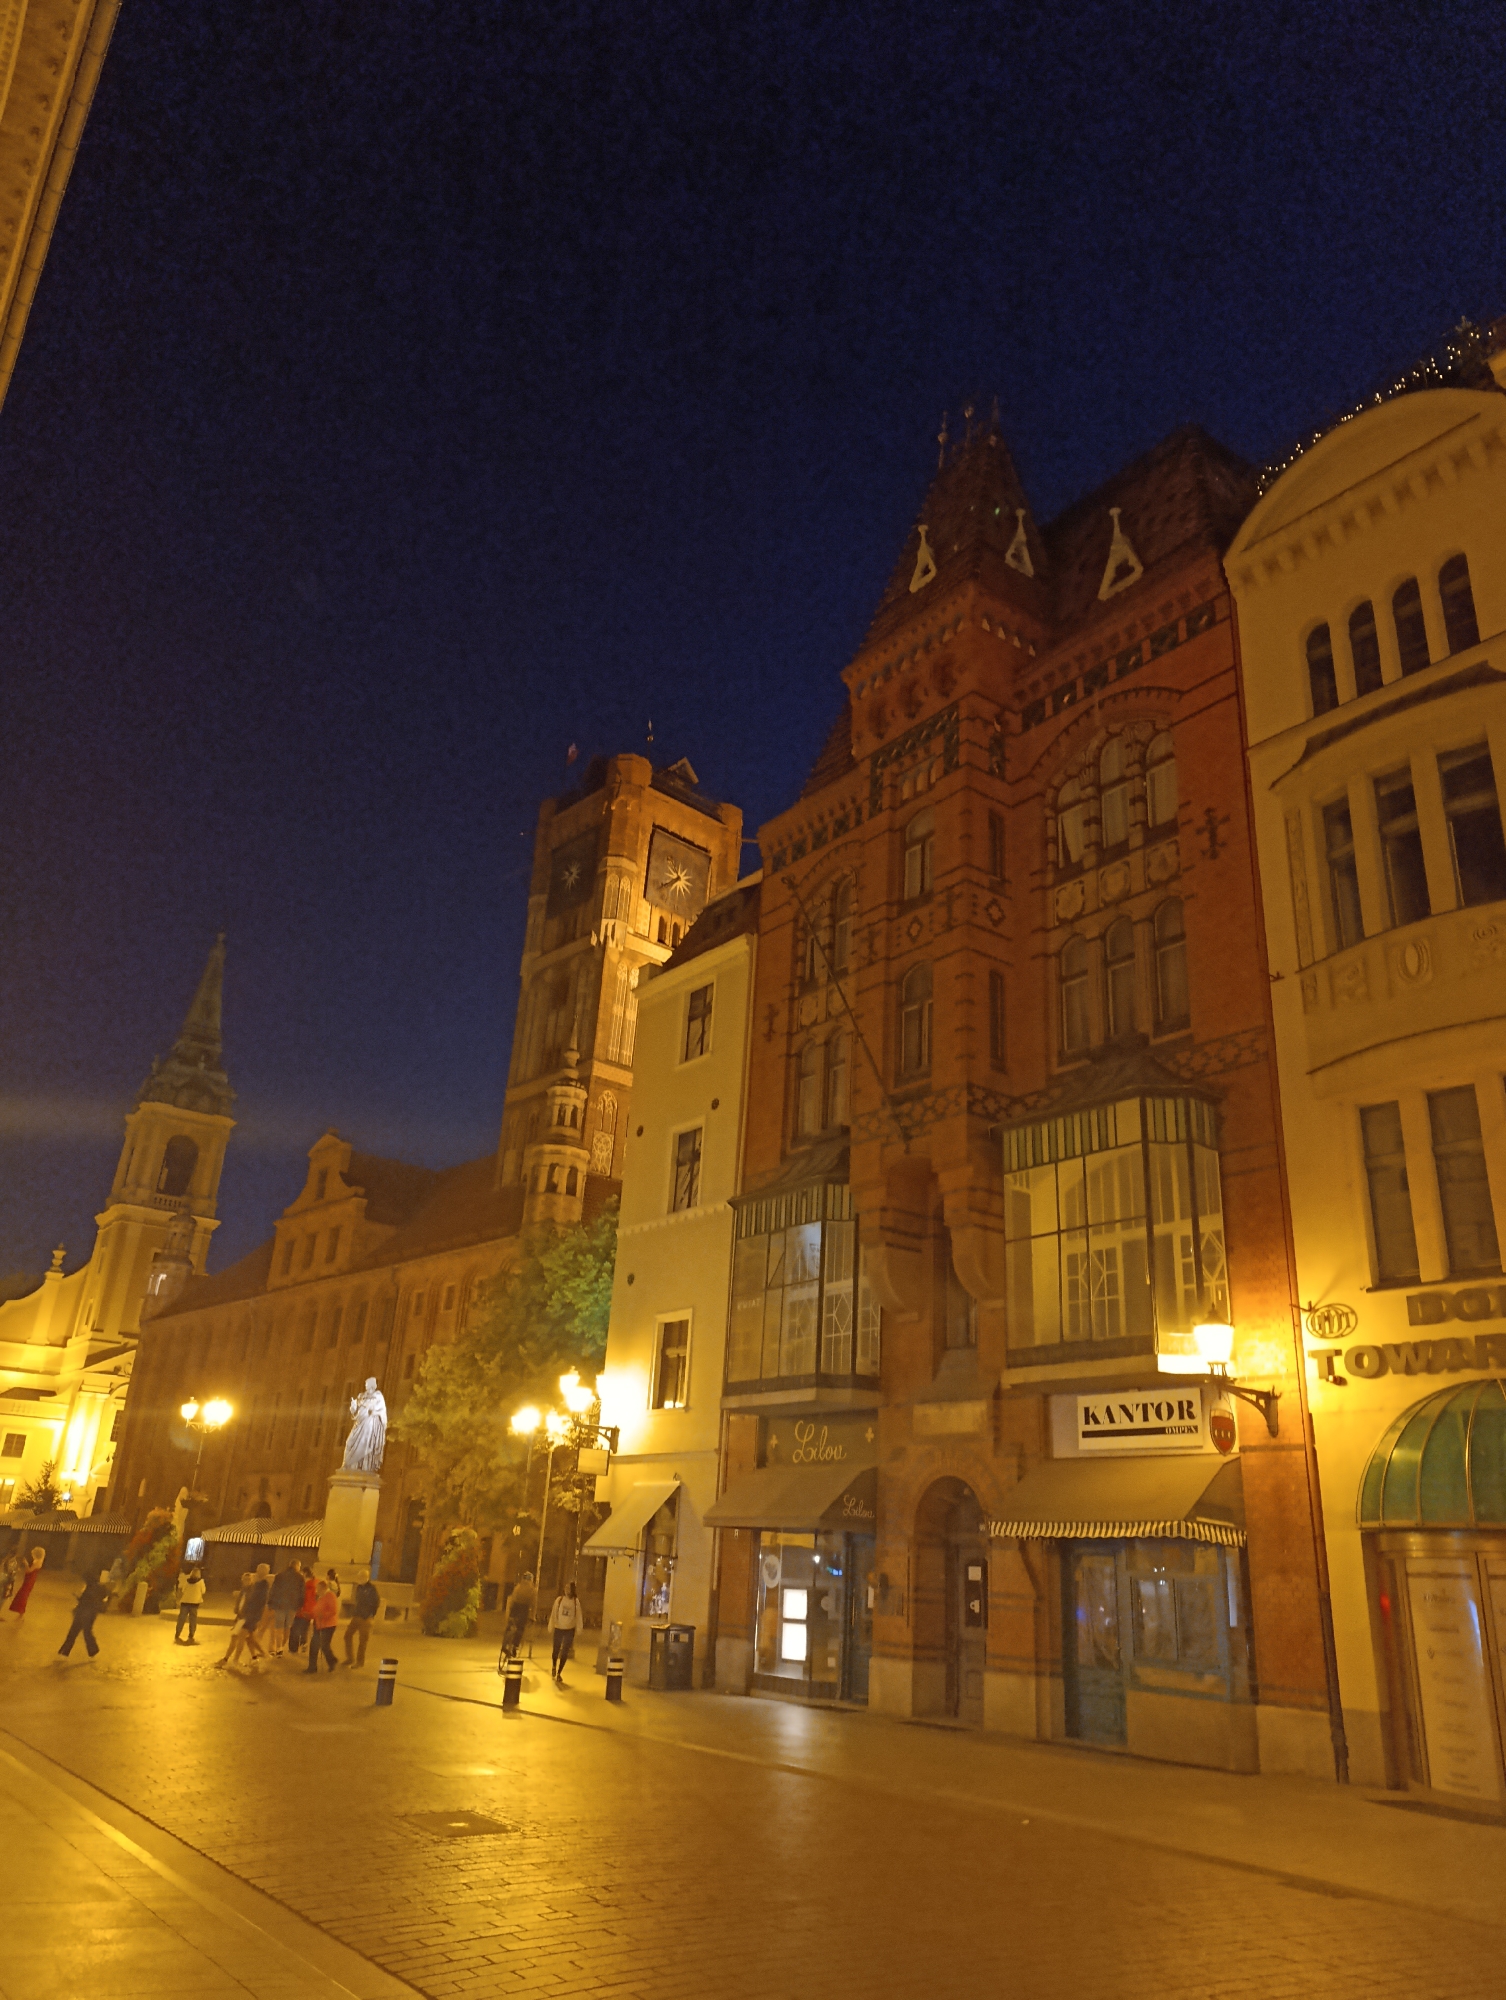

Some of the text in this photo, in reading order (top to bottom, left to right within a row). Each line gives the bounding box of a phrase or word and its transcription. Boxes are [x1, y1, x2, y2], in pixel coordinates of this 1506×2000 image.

[1406, 1284, 1506, 1326] DO
[1084, 1400, 1198, 1425] KANTOR
[793, 1420, 847, 1463] Lilou
[842, 1494, 875, 1518] Lilou
